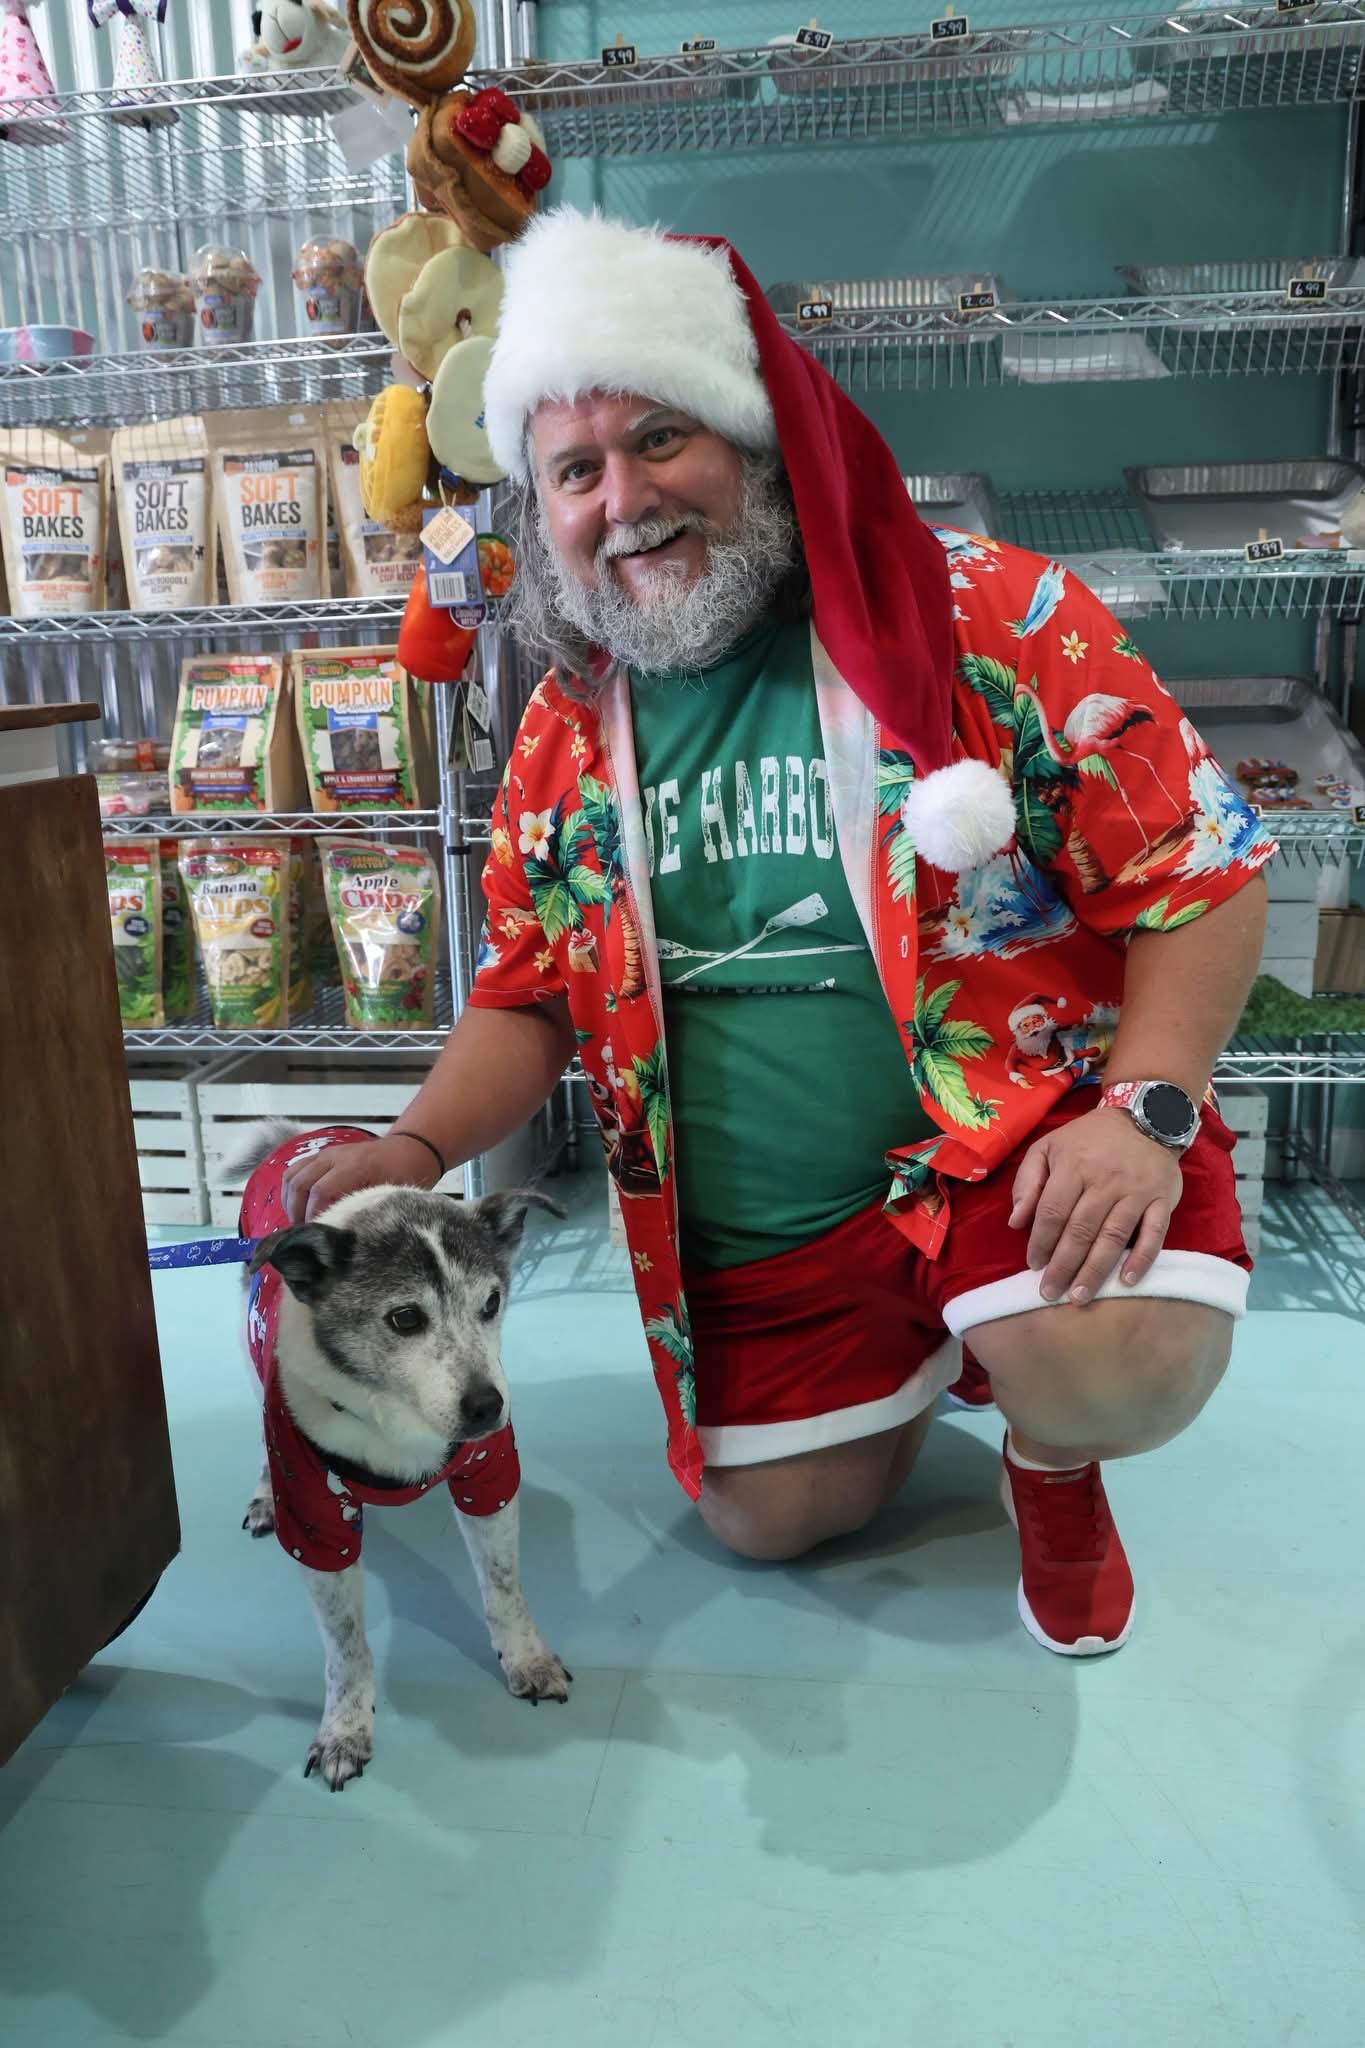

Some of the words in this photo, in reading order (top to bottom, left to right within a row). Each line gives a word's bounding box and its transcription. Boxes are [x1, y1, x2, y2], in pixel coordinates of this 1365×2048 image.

[937, 21, 963, 36] 5.99
[606, 48, 633, 65] 3.99
[136, 481, 188, 509] SOFT
[240, 473, 298, 504] SOFT
[22, 488, 82, 516] SOFT
[136, 508, 188, 533] BAKES
[242, 502, 301, 527] BAKES
[23, 516, 84, 538] BAKES
[194, 686, 266, 708] PUMPKIN
[312, 681, 391, 706] PUMPKIN
[202, 881, 257, 895] Banana
[352, 876, 398, 890] Apple
[341, 890, 420, 913] Chips
